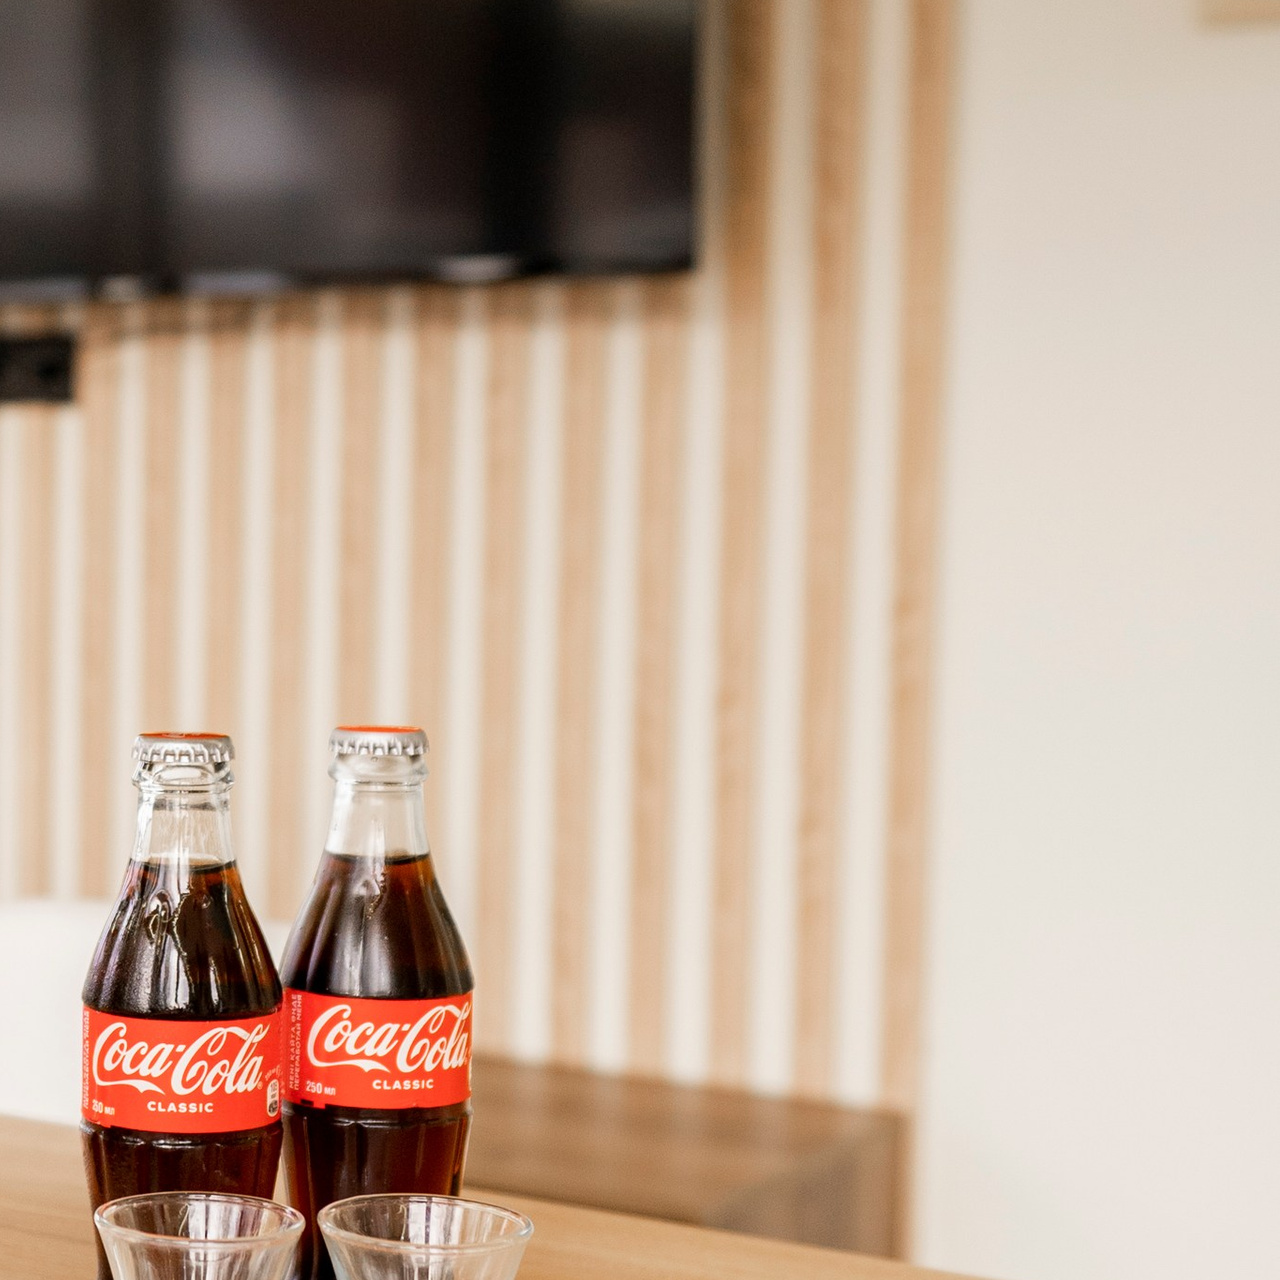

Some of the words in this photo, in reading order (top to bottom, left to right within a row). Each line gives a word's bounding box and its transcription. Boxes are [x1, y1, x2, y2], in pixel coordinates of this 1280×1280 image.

[306, 1004, 471, 1073] Coca-Cola
[93, 1022, 270, 1096] Coca-Cola
[306, 1081, 322, 1094] 250
[324, 1086, 336, 1096] мл
[372, 1078, 434, 1091] CLASSIC
[104, 1106, 116, 1115] мл
[147, 1101, 214, 1113] CLASSIC
